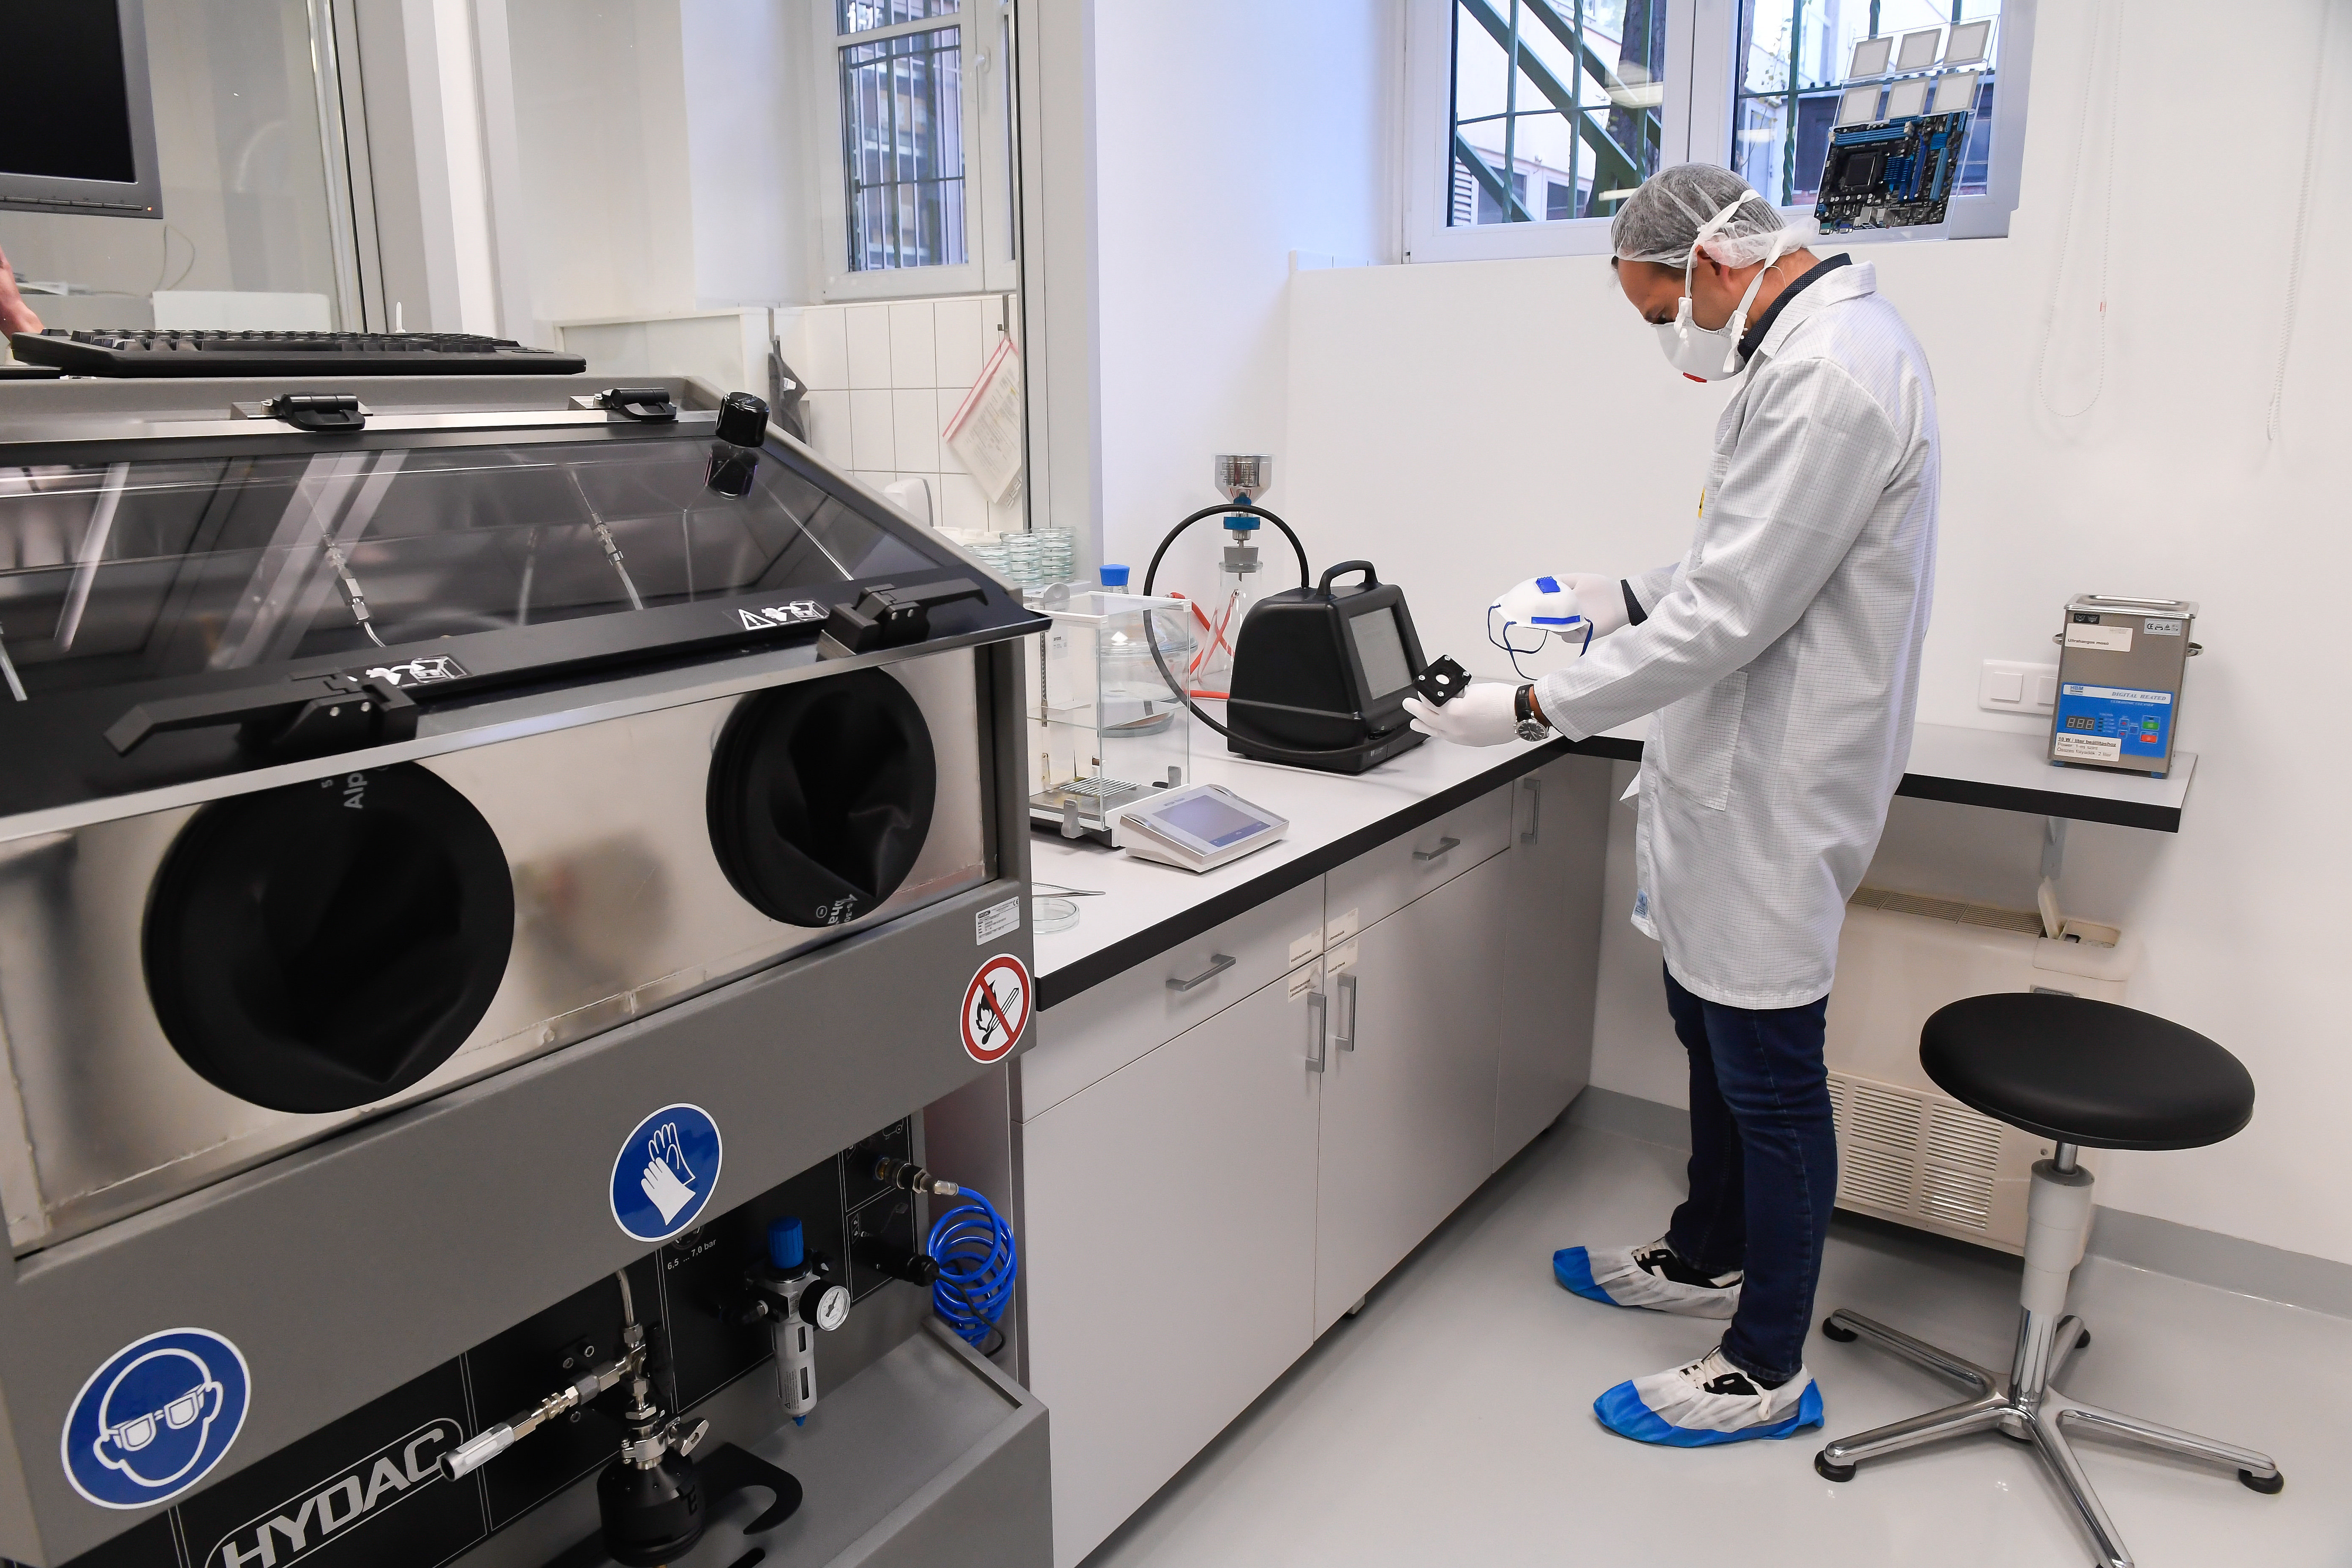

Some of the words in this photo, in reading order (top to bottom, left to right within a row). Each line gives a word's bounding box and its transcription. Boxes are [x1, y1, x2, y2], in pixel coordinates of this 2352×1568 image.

[667, 1258, 679, 1270] 6,5
[691, 1246, 702, 1257] 7,0
[704, 1239, 716, 1250] bar
[222, 1428, 446, 1568] HYDAC
